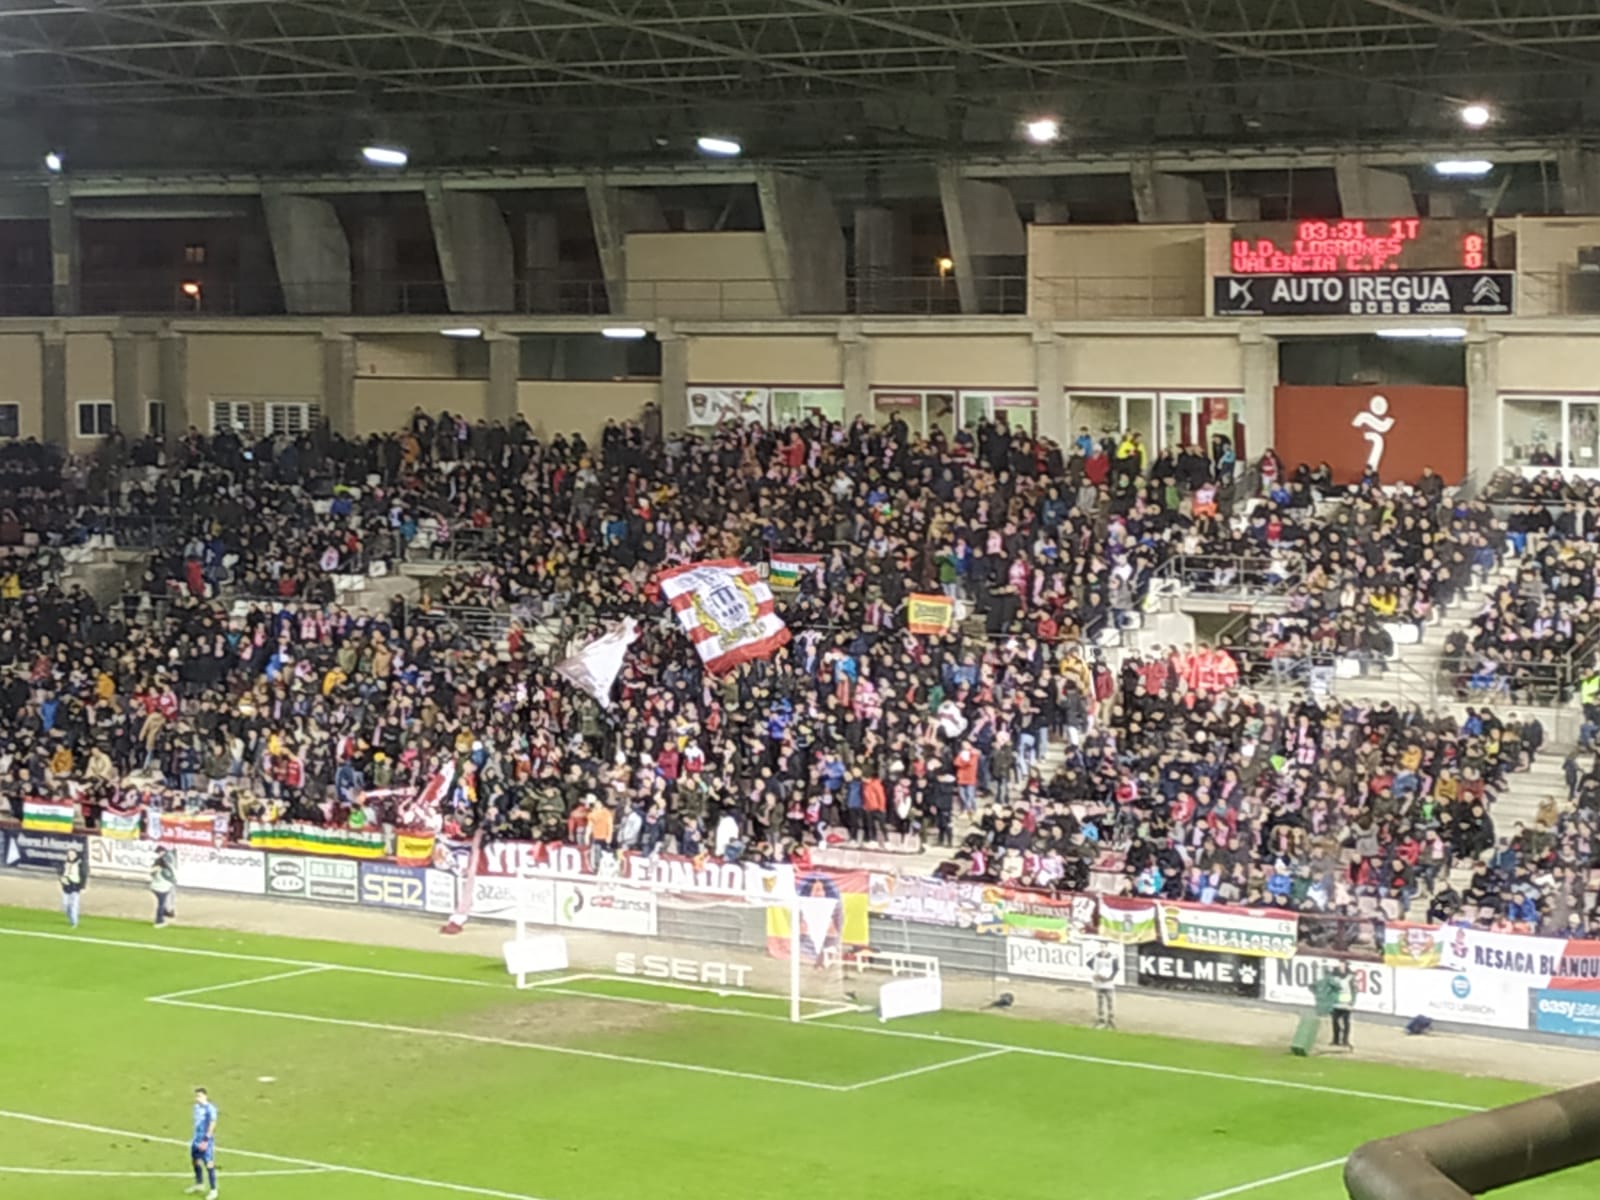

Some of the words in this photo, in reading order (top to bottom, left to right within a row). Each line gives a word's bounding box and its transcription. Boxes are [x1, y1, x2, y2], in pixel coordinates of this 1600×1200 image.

[1300, 221, 1364, 240] 03:31
[1391, 219, 1419, 240] 1T
[1233, 240, 1284, 257] U.D.
[1233, 254, 1337, 272] VALENCIA
[1346, 254, 1399, 271] C.F.
[1465, 251, 1483, 269] 0
[1272, 277, 1343, 303] AUTO
[1350, 276, 1450, 301] IREGUA
[363, 873, 424, 907] SER
[643, 954, 753, 988] SEAT
[1140, 955, 1235, 983] KELME
[1277, 956, 1383, 996] Notias
[1474, 945, 1535, 975] RESACA
[1540, 954, 1600, 979] BLANQU
